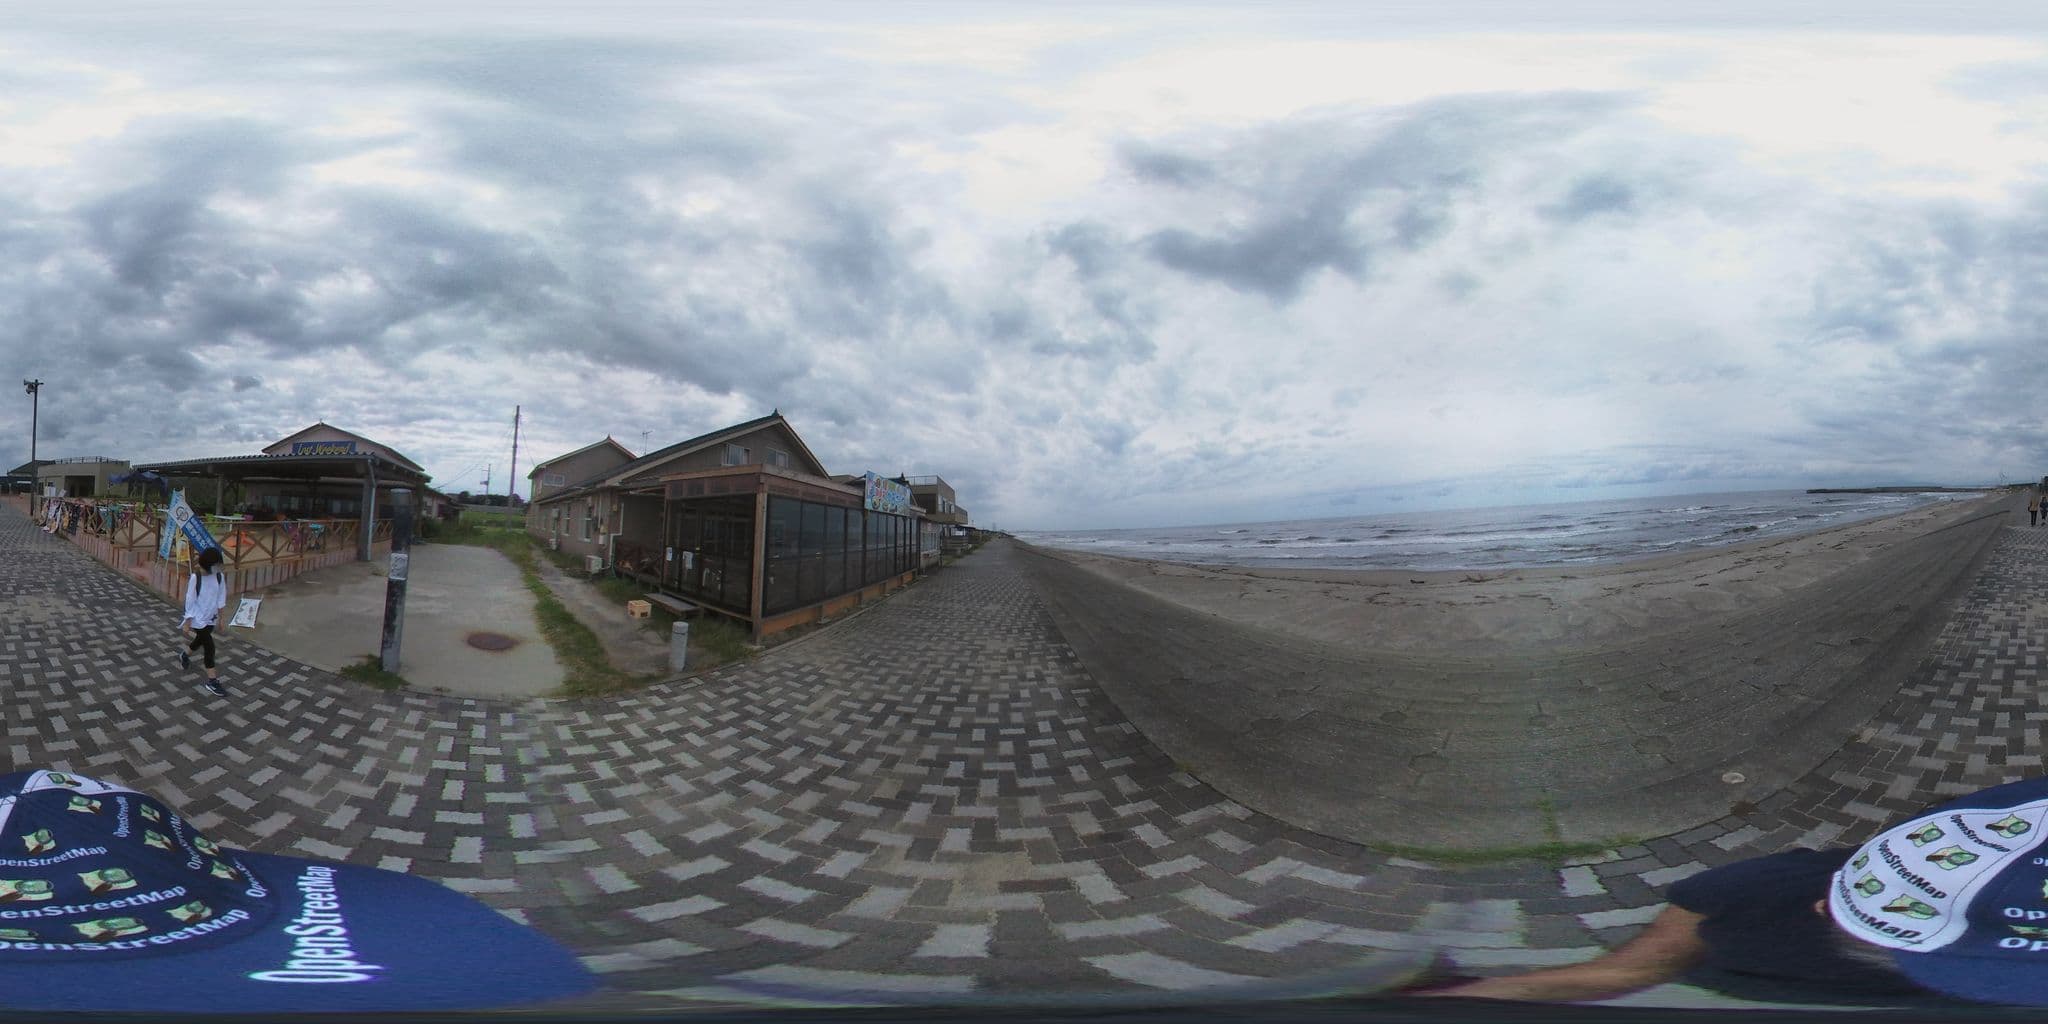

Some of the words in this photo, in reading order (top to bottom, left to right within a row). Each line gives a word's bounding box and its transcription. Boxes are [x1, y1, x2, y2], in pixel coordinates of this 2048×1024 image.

[1877, 838, 1948, 899] OpenStreetMap
[0, 885, 187, 919] enStreetMap
[248, 866, 384, 982] OpenStreetMap
